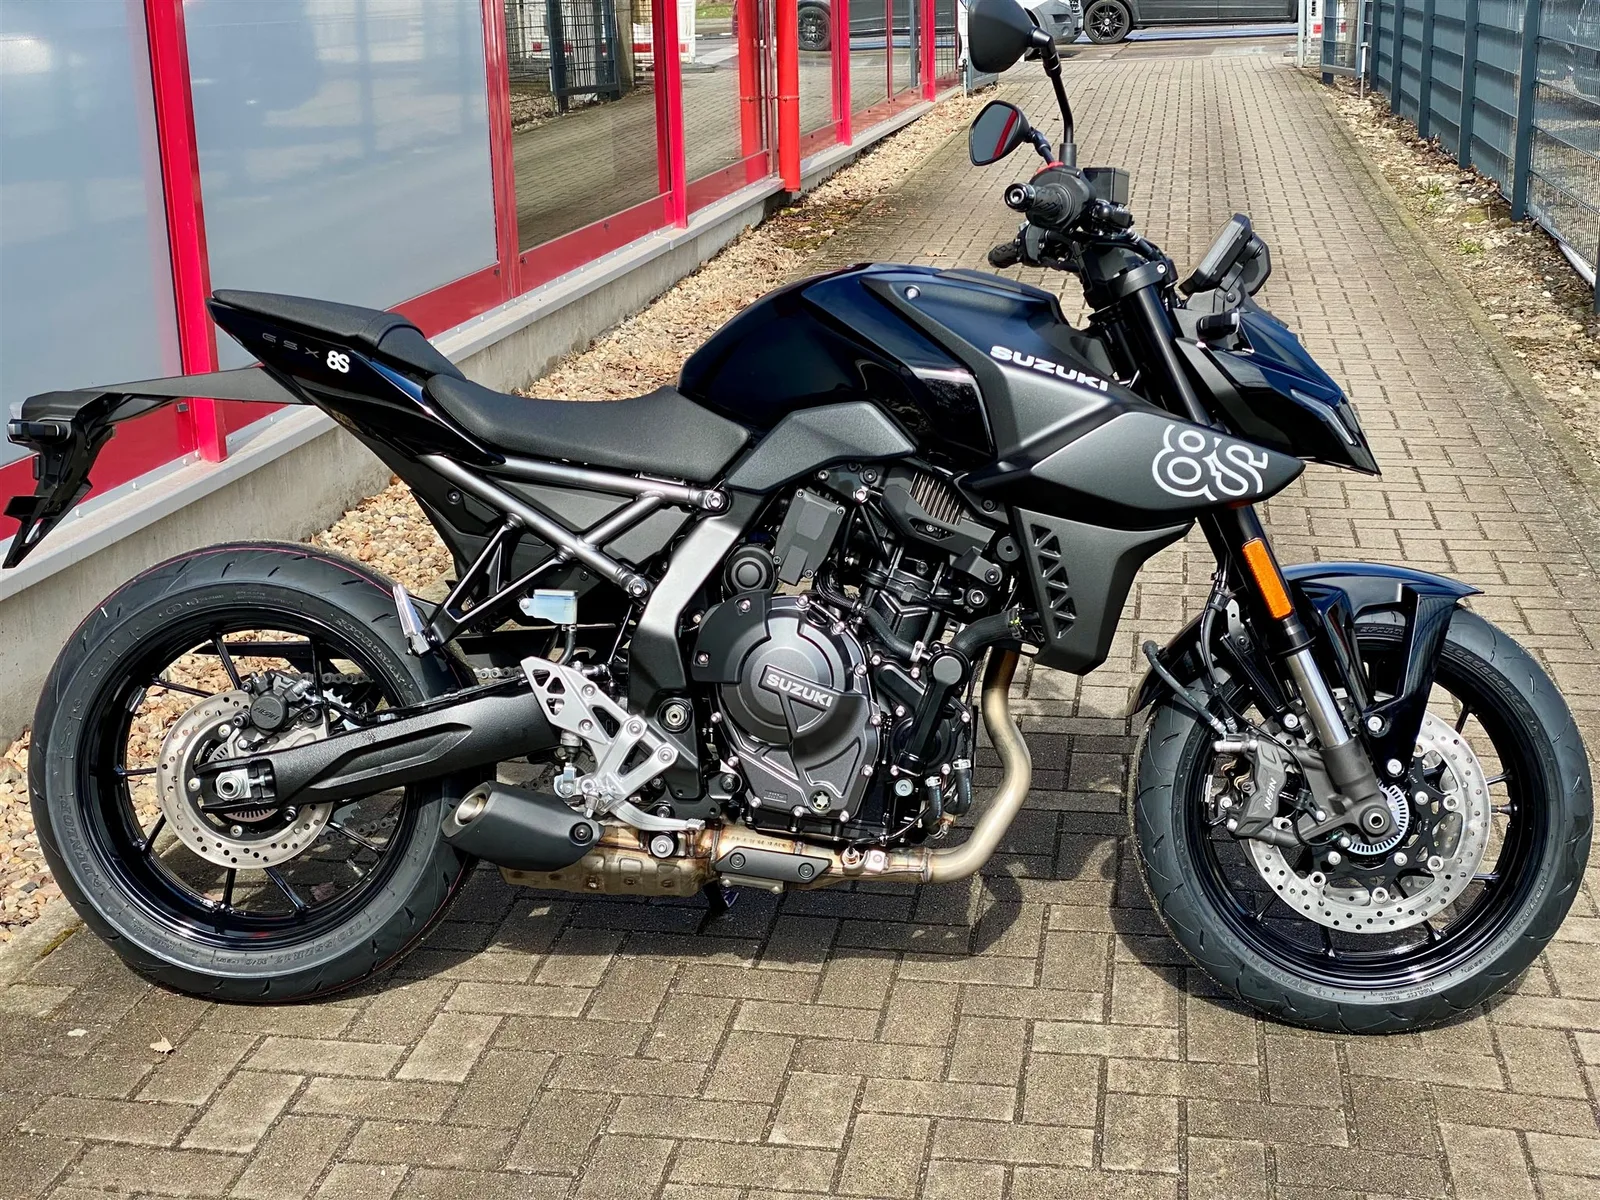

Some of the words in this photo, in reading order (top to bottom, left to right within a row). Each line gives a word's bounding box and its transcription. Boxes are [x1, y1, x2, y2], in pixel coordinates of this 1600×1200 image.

[326, 350, 350, 374] 8S
[990, 345, 1108, 392] SUZUKI
[766, 673, 834, 708] SUZUKI
